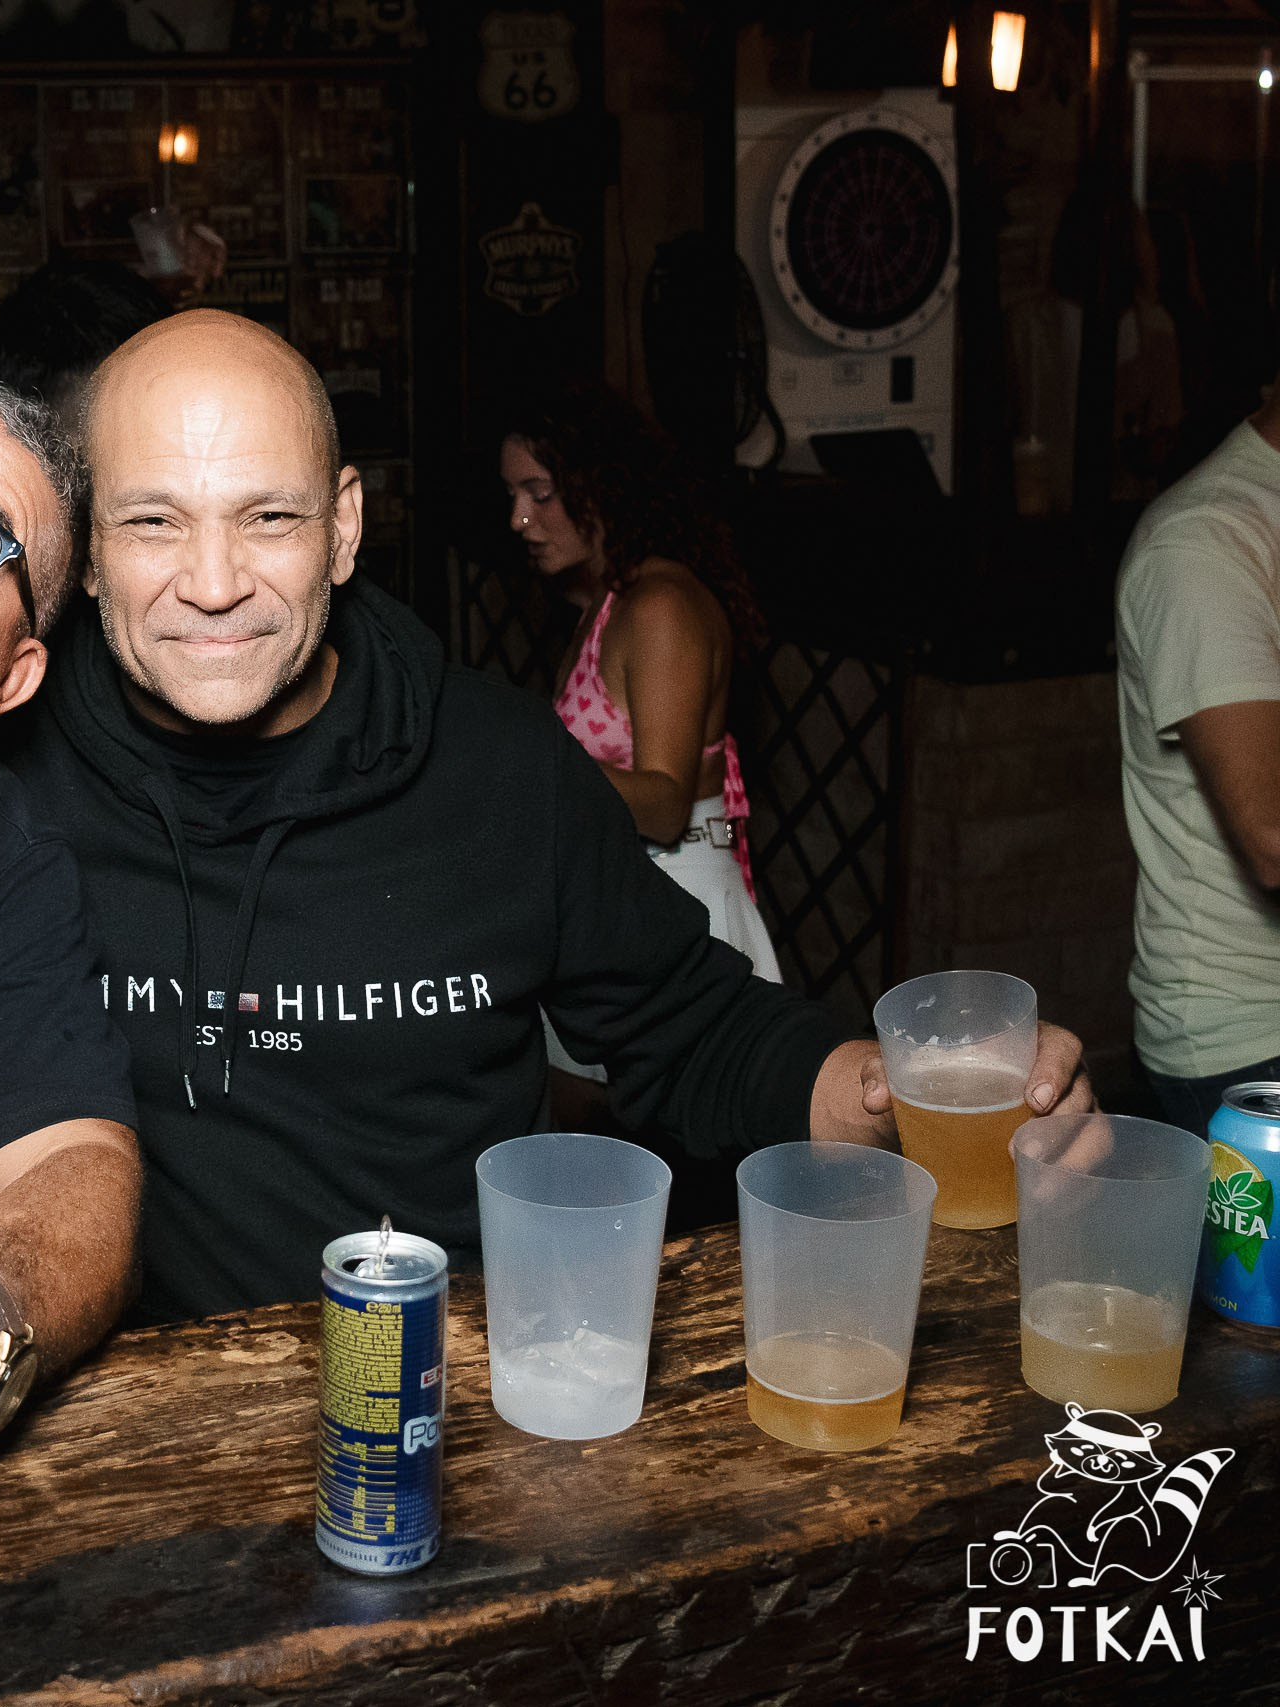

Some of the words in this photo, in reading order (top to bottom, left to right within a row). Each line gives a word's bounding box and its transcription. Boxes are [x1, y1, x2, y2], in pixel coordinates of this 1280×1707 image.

[505, 70, 557, 110] 66
[276, 973, 493, 1021] HILFIGER
[248, 1029, 303, 1052] 1985
[384, 1543, 423, 1567] THE
